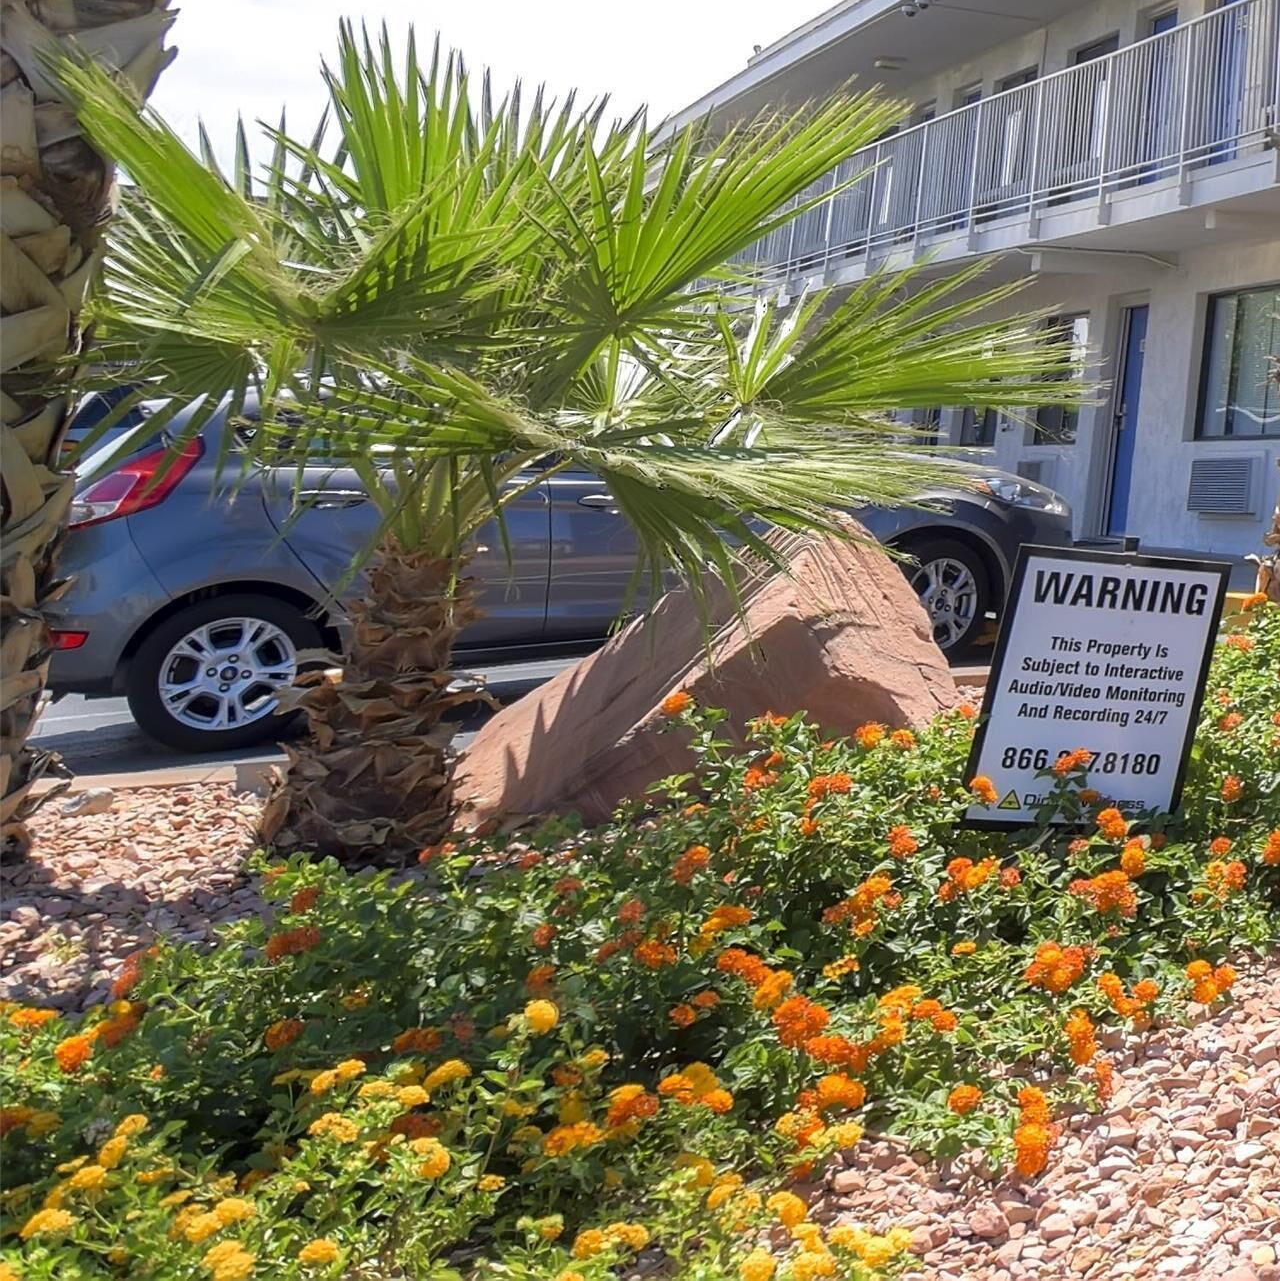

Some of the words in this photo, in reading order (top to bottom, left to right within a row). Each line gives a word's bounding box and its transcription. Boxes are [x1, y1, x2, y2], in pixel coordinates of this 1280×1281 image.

[1033, 569, 1209, 617] WARNING
[1050, 636, 1082, 653] This
[1086, 639, 1151, 660] Property
[1155, 644, 1169, 658] Is
[1021, 657, 1080, 677] Subject
[1085, 662, 1100, 677] to
[1104, 664, 1184, 682] Interactive
[1008, 679, 1101, 699] Audio/Video
[1105, 686, 1186, 707] Monitoring
[1018, 702, 1048, 719] And
[1053, 706, 1129, 727] Recording
[1135, 709, 1169, 725] 24/7
